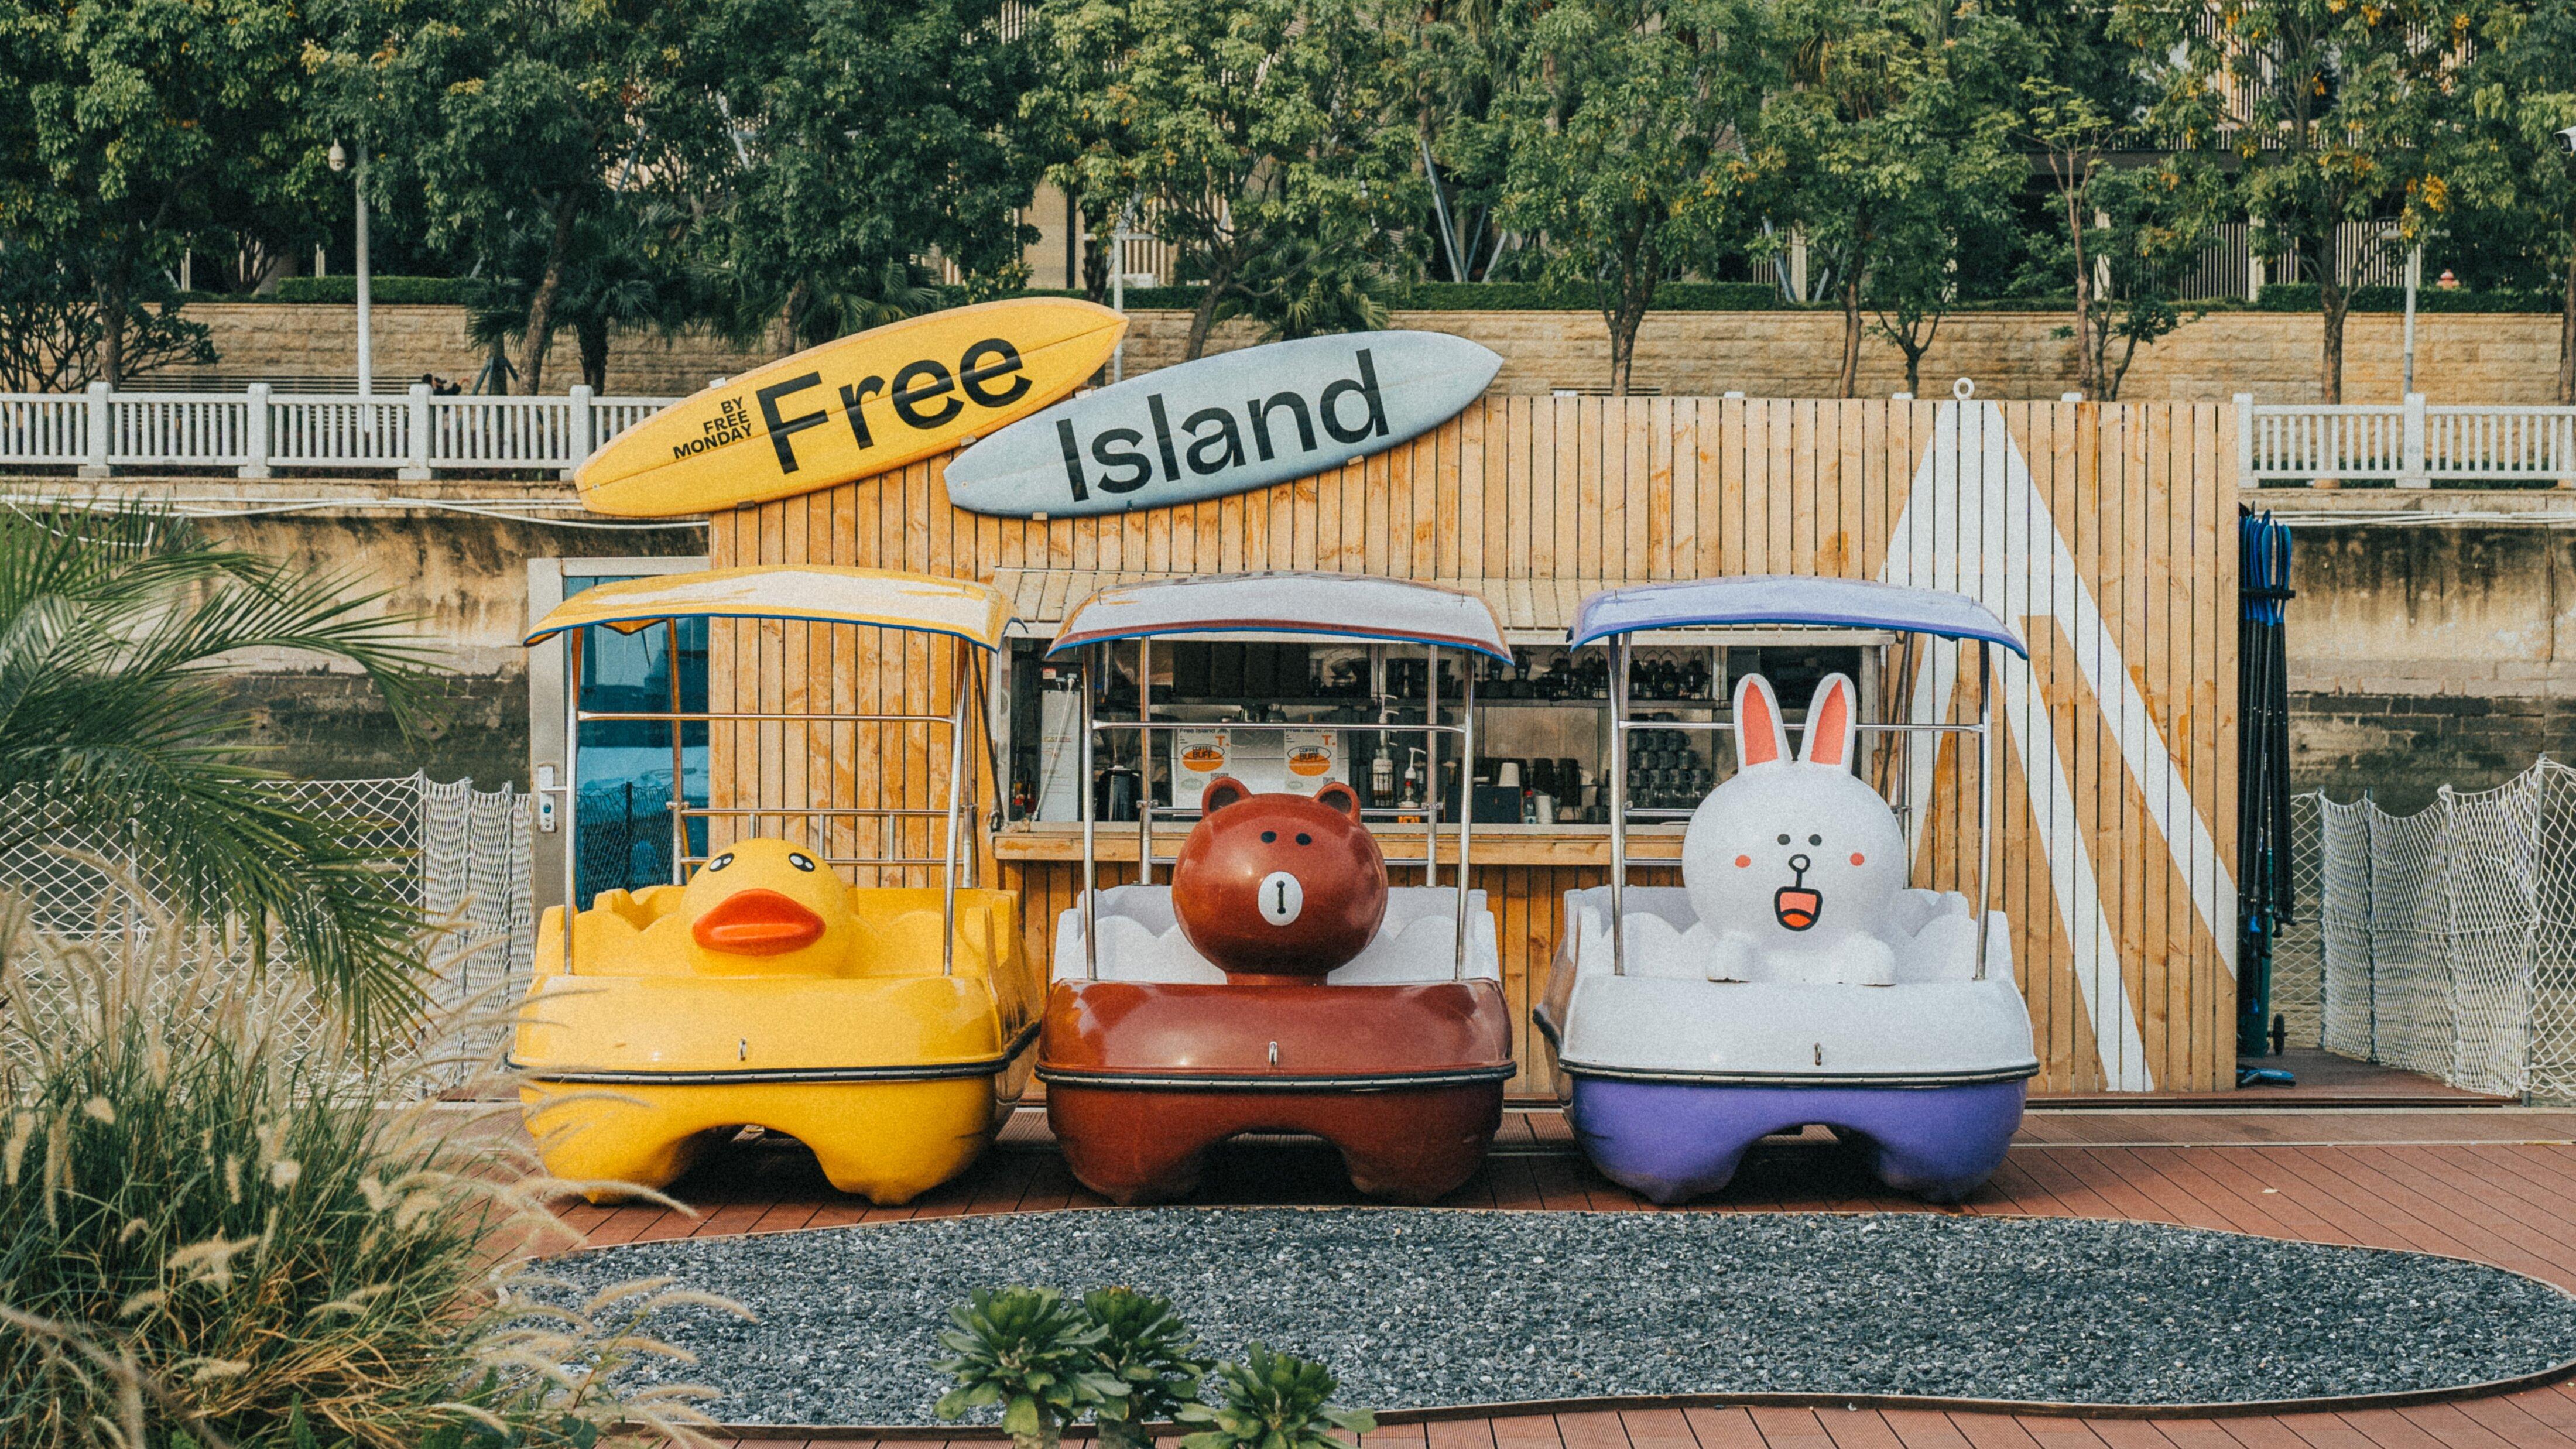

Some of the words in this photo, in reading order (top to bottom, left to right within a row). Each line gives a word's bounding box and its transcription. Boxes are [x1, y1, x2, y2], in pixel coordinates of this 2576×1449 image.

[703, 410, 750, 434] FREE
[721, 396, 742, 415] BY
[756, 338, 1032, 475] Free
[673, 423, 751, 459] MONDAY
[1057, 349, 1389, 502] Island
